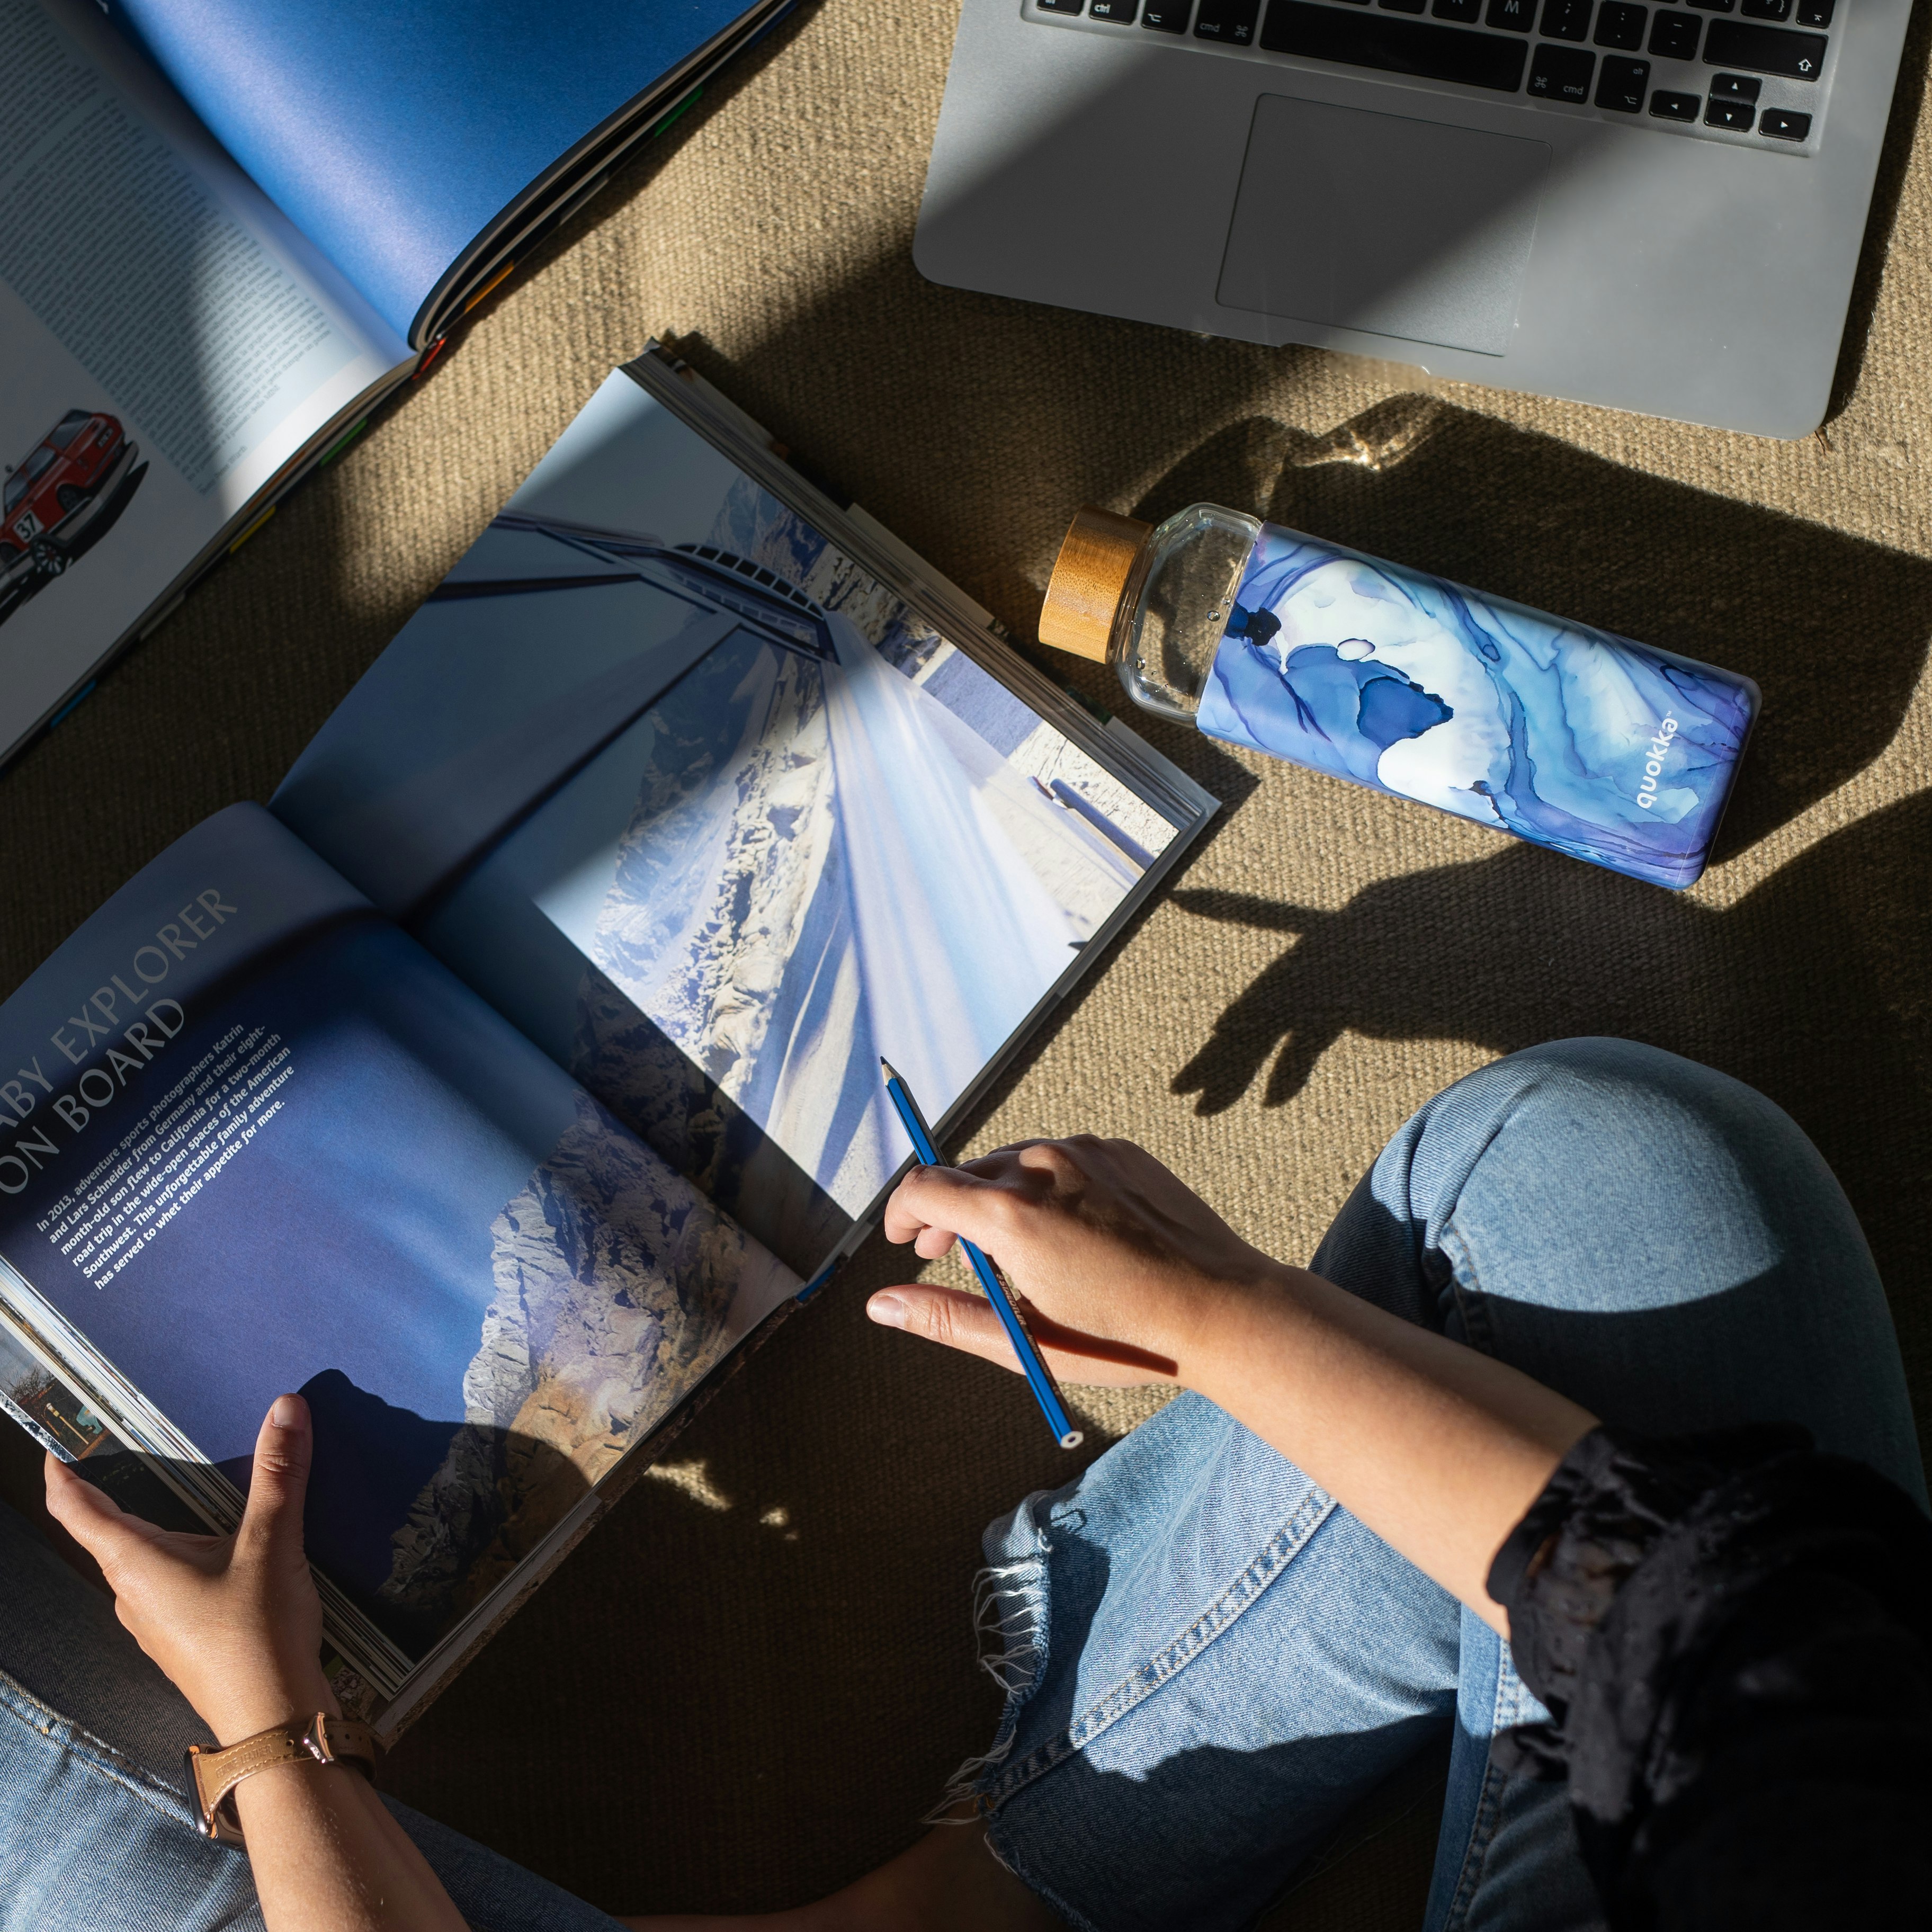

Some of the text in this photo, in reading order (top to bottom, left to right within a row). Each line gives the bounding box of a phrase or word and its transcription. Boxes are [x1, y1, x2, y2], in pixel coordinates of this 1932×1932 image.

[1200, 23, 1221, 32] cmd
[1504, 0, 1519, 14] M
[1563, 85, 1584, 95] cmd
[17, 513, 36, 539] 37
[1636, 718, 1678, 809] quokka
[50, 888, 238, 1066] EXPLORER
[0, 998, 185, 1194] ON BOARD
[37, 1024, 244, 1231] In 2013, adventure sports photographers Katrin
[50, 1026, 265, 1243] and Lars Schneider from Germany and their eight-
[61, 1034, 281, 1255] month-old son flew to California for a two-month
[73, 1047, 290, 1266] road trip in the wide-open spaces of the American
[83, 1066, 294, 1278] Southwest. This unforgettable family adventure
[94, 1101, 285, 1290] has served to whet their appetite for more.
[999, 1278, 1027, 1325] STAEDTLER
